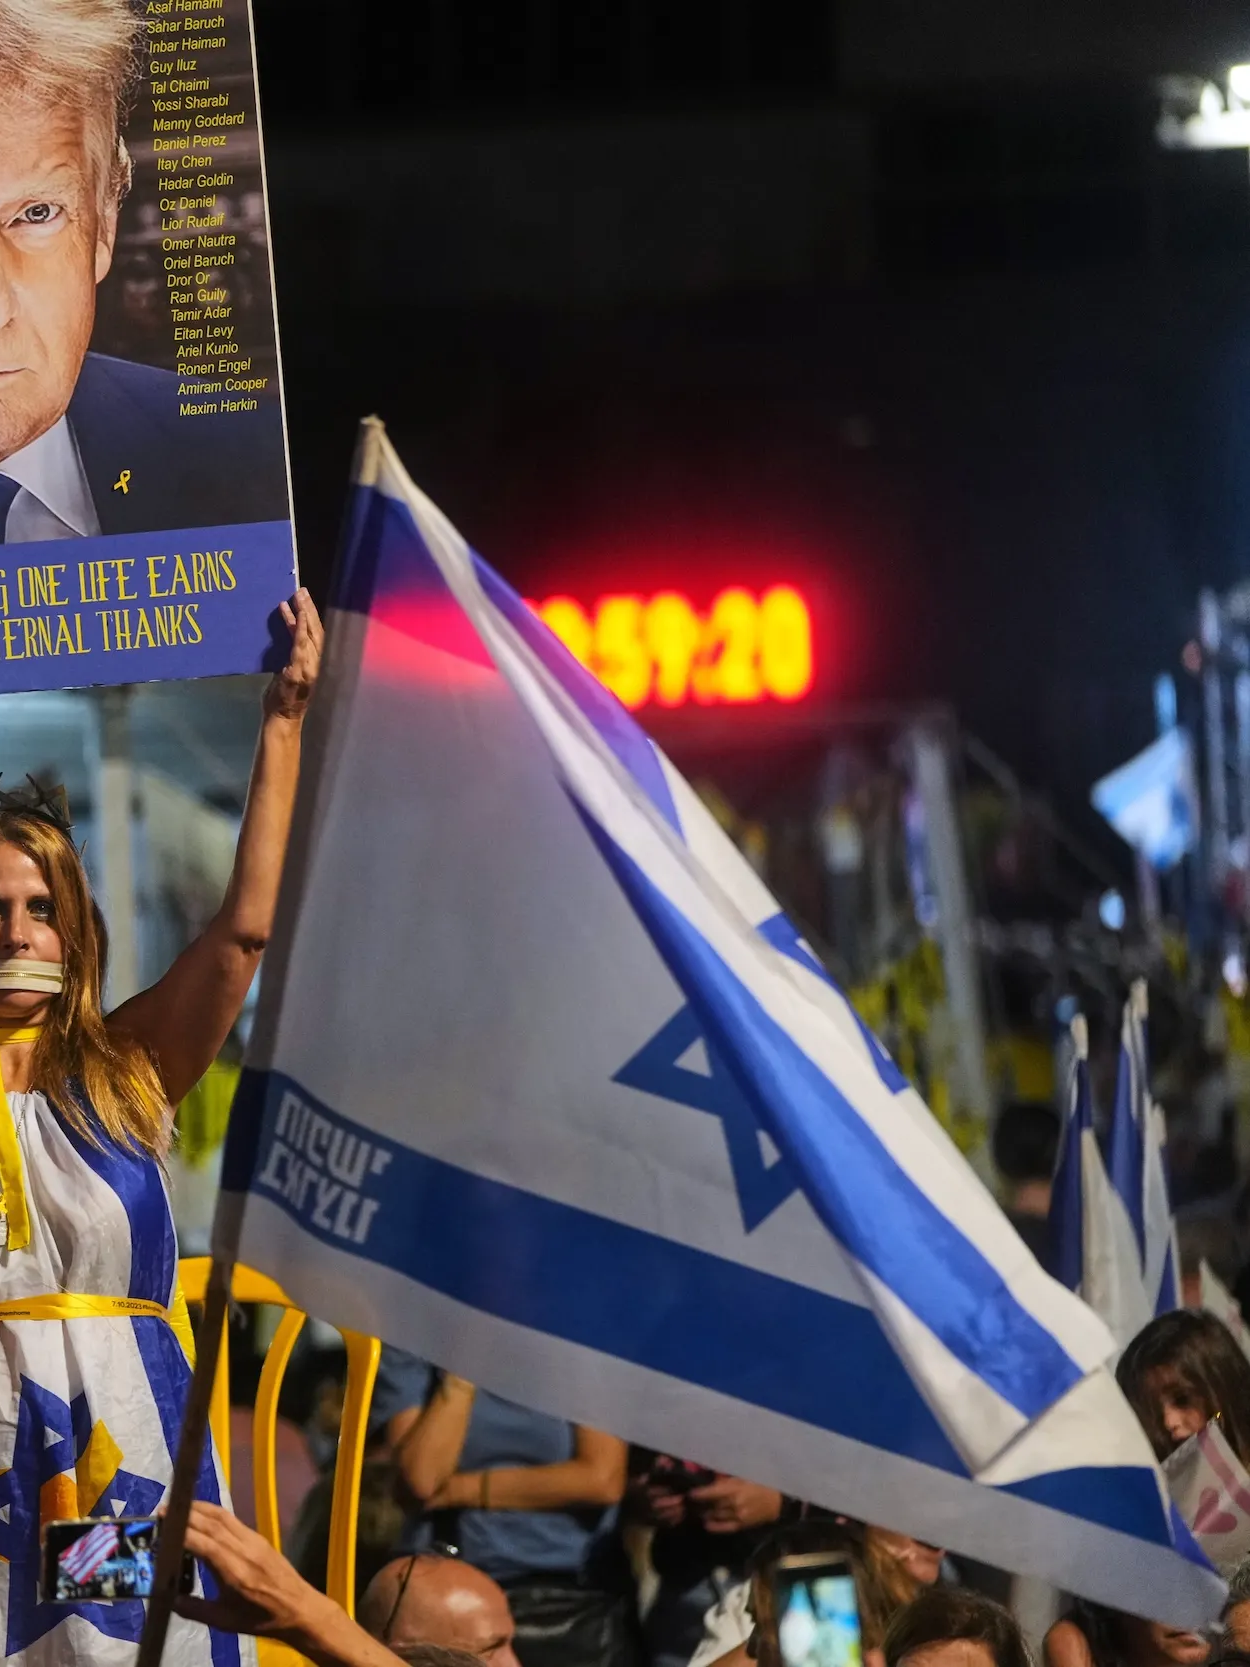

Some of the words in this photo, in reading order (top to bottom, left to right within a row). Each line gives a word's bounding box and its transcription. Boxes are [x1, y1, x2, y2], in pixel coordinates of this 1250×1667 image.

[146, 0, 172, 14] Asaf
[147, 20, 182, 33] Sahar
[184, 15, 224, 30] Baruch
[150, 40, 179, 53] Inbar
[182, 37, 226, 50] Haiman
[150, 61, 173, 75] Guy
[151, 81, 166, 94] Tal
[170, 77, 209, 92] Chaimi
[152, 98, 181, 112] Yossi
[185, 93, 229, 109] Sharabi
[153, 119, 191, 132] Manny
[195, 112, 245, 128] Goddard
[153, 136, 189, 151] Daniel
[193, 135, 226, 147] Perez
[158, 158, 178, 172] Itay
[182, 155, 211, 168] Chen
[159, 177, 194, 191] Hadar
[197, 173, 233, 187] Goldin
[160, 198, 176, 211] Oz
[180, 195, 215, 209] Daniel
[162, 218, 184, 230] Lior
[162, 238, 194, 251] Omer
[198, 234, 236, 248] Nautra
[194, 252, 234, 267] Baruch
[167, 274, 192, 287] Dror
[196, 272, 210, 284] Or
[170, 292, 193, 304] Ran
[171, 308, 202, 322] Tamir
[204, 306, 232, 319] Adar
[174, 327, 203, 340] Eitan
[207, 325, 234, 338] Levy
[177, 344, 202, 358] Ariel
[206, 341, 238, 355] Kunio
[178, 363, 214, 376] Ronen
[218, 358, 251, 374] Engel
[177, 382, 221, 395] Amiram
[225, 378, 267, 392] Cooper
[180, 402, 217, 416] Maxim
[221, 398, 257, 412] Harkin
[17, 564, 69, 607] ONE
[80, 558, 138, 602] LIFE
[148, 550, 238, 598] EARNS
[96, 604, 203, 651] THANKS
[112, 1301, 141, 1309] 7.10.2023
